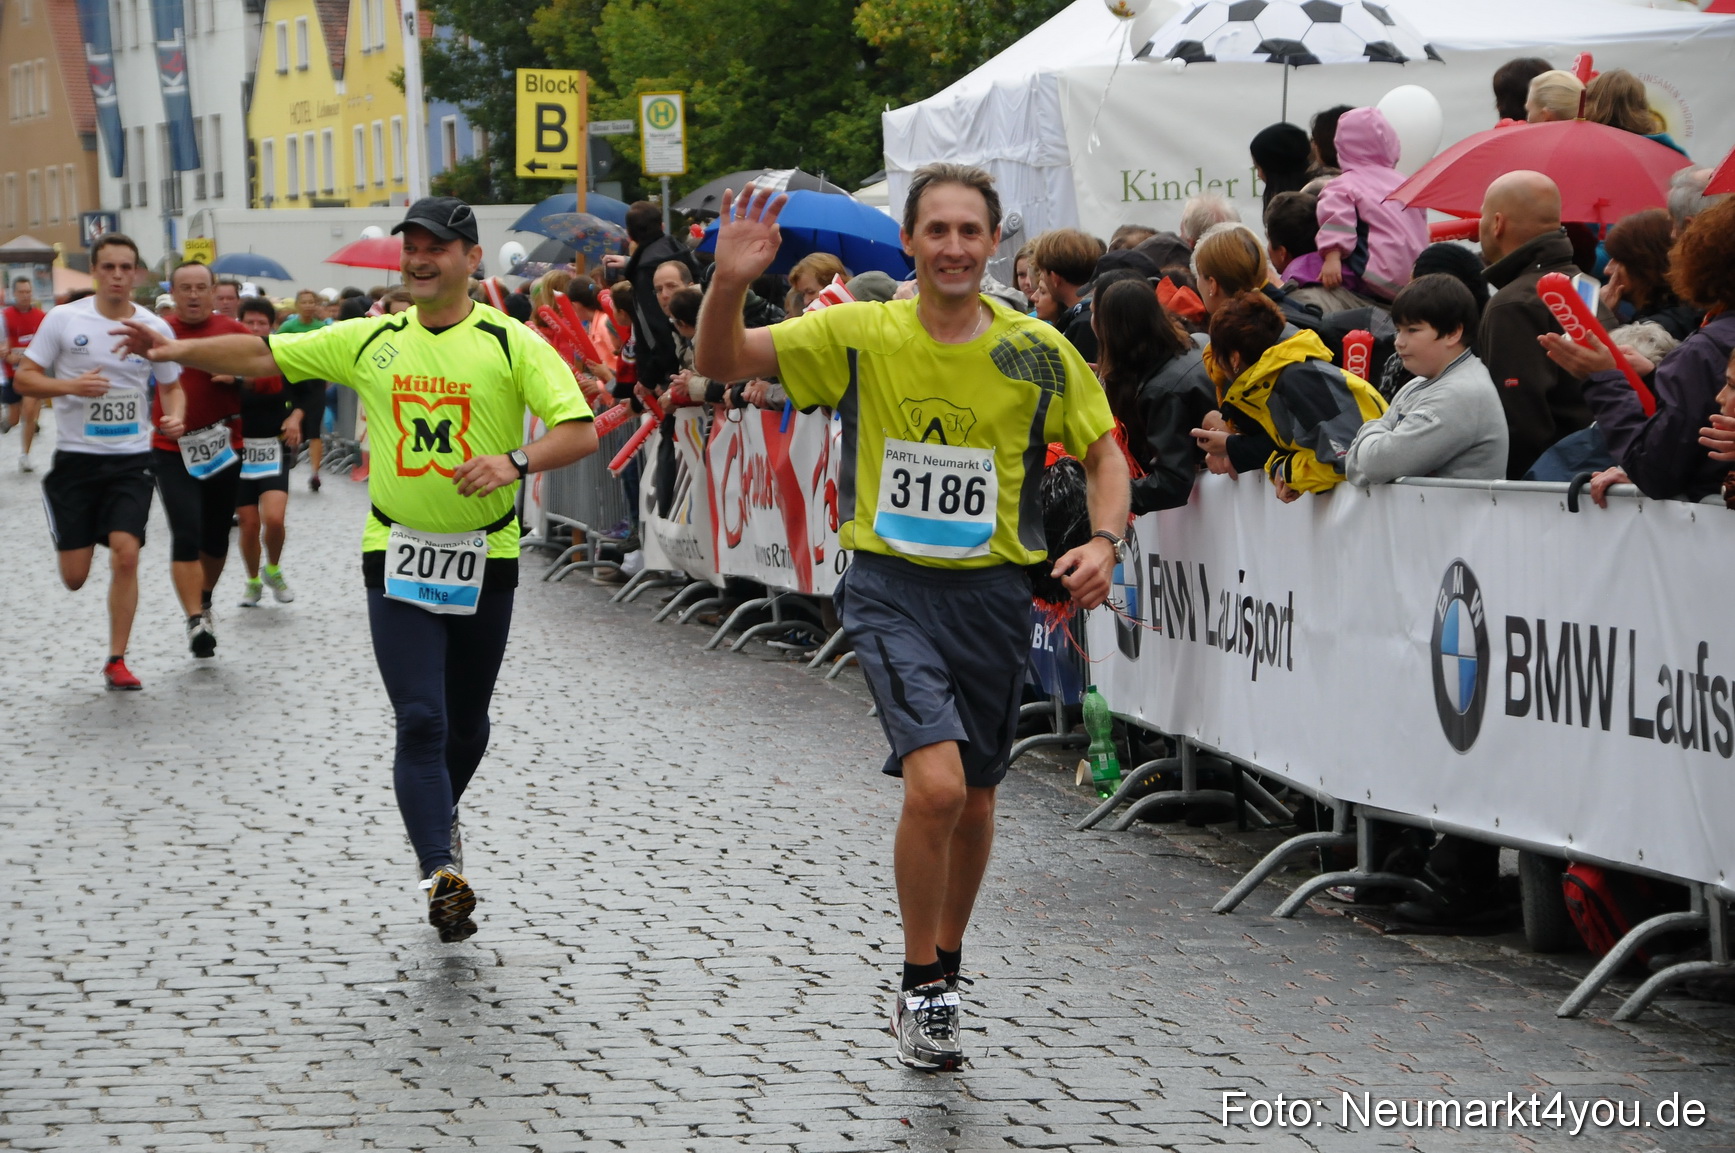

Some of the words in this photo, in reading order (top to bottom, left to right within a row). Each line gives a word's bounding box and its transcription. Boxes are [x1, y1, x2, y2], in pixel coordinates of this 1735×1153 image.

[525, 73, 578, 94] Block
[535, 102, 568, 153] B
[1120, 167, 1239, 202] Kinder
[392, 374, 472, 395] Müller
[90, 401, 136, 422] 2638
[412, 417, 453, 454] M
[886, 449, 920, 465] PARTL
[923, 455, 980, 470] Neumarkt
[890, 468, 987, 516] 3186
[396, 544, 477, 582] 2070
[418, 587, 449, 602] Mike
[1505, 614, 1618, 732] BMW
[1628, 628, 1735, 760] Laufs
